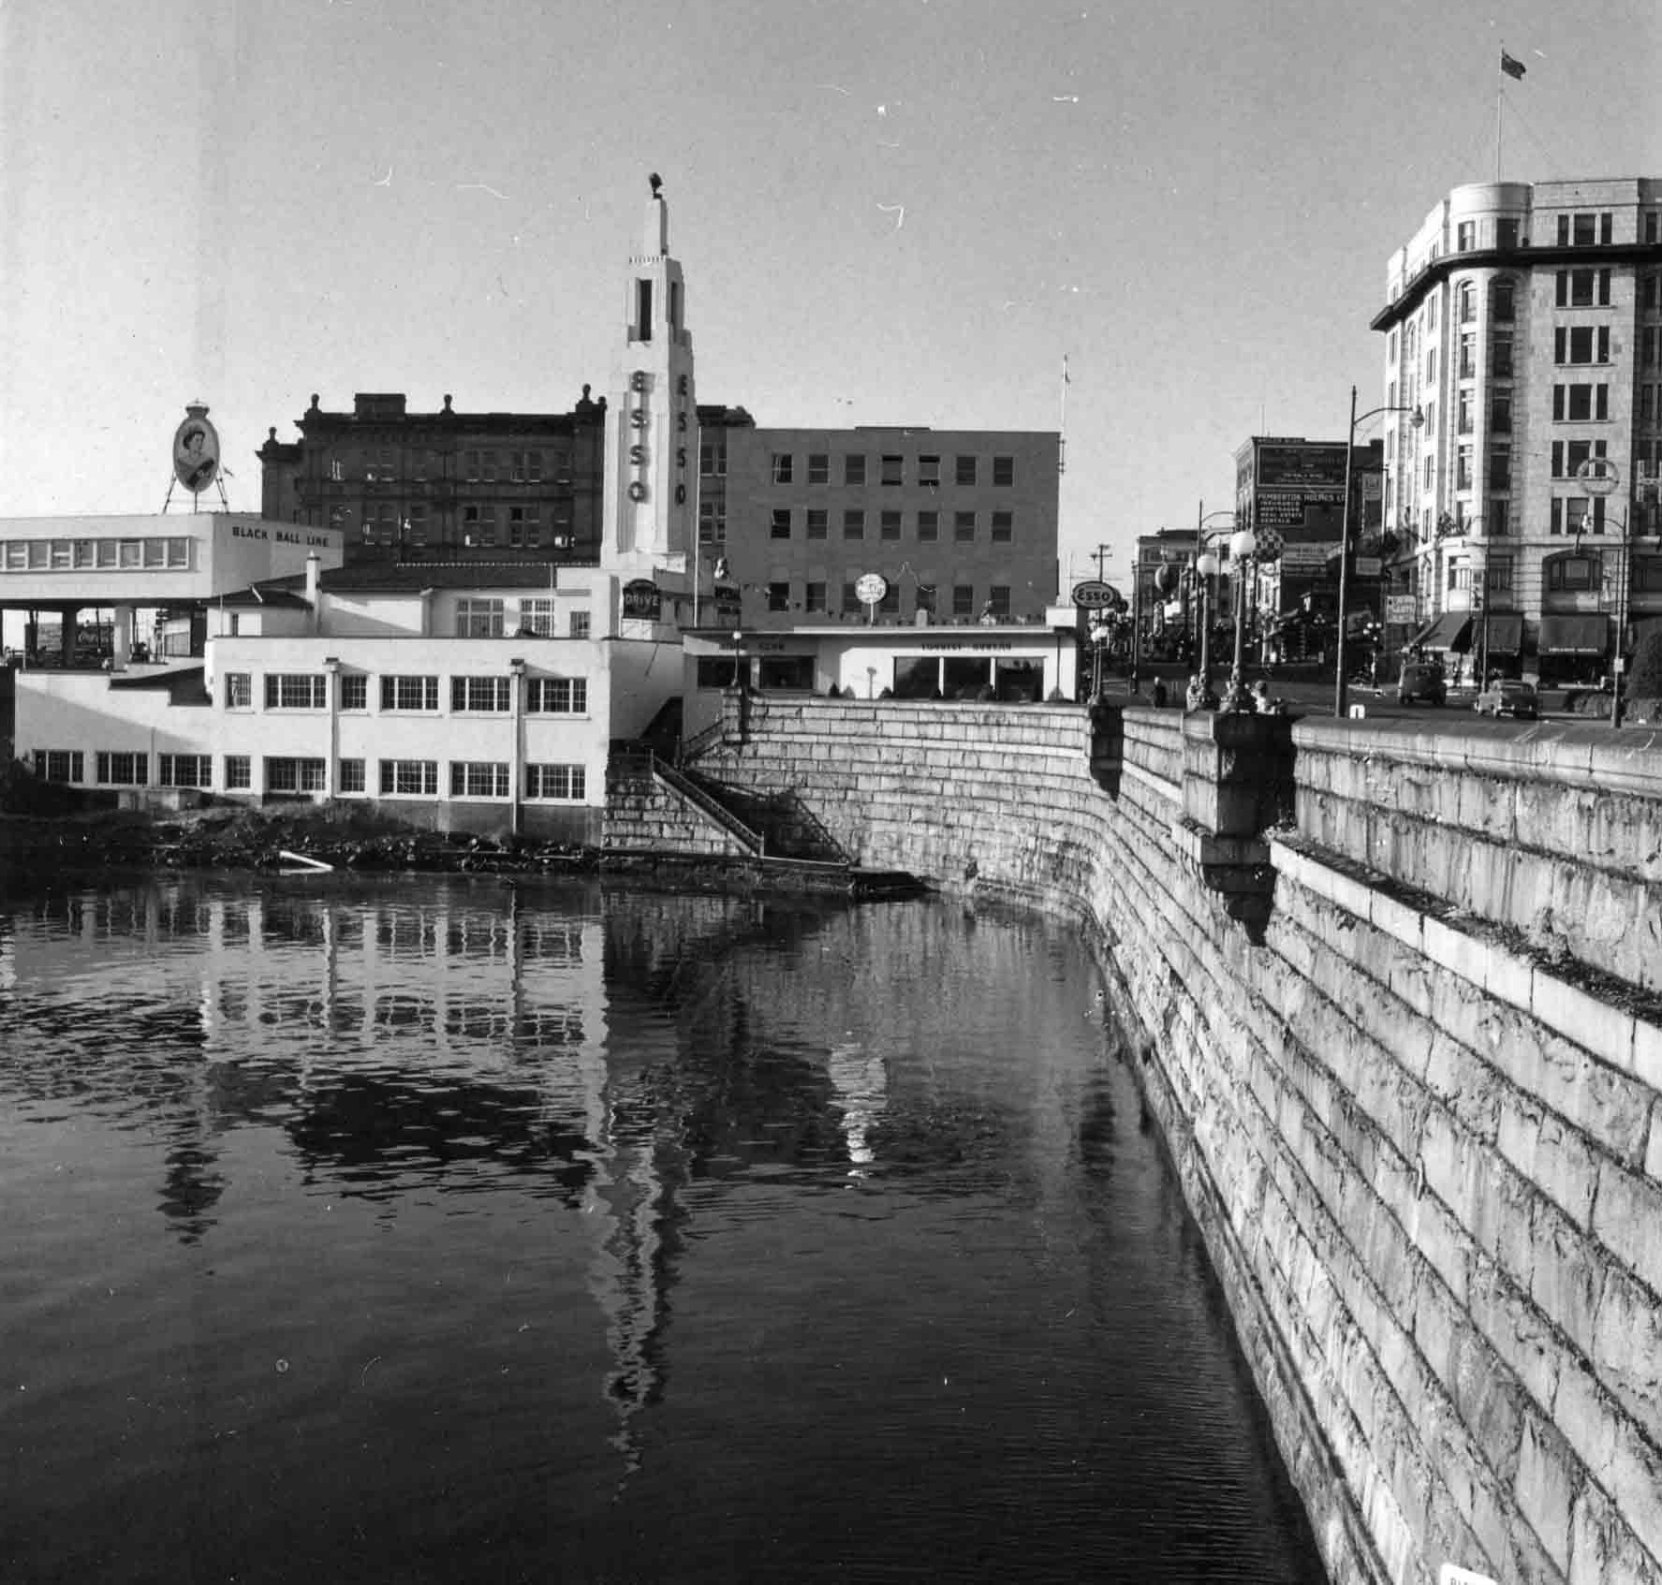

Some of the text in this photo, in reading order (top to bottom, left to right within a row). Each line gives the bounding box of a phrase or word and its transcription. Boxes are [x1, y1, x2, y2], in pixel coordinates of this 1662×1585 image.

[628, 370, 645, 503] ESSO
[675, 374, 687, 505] ESSO
[232, 526, 328, 548] BLACK BALL LINE
